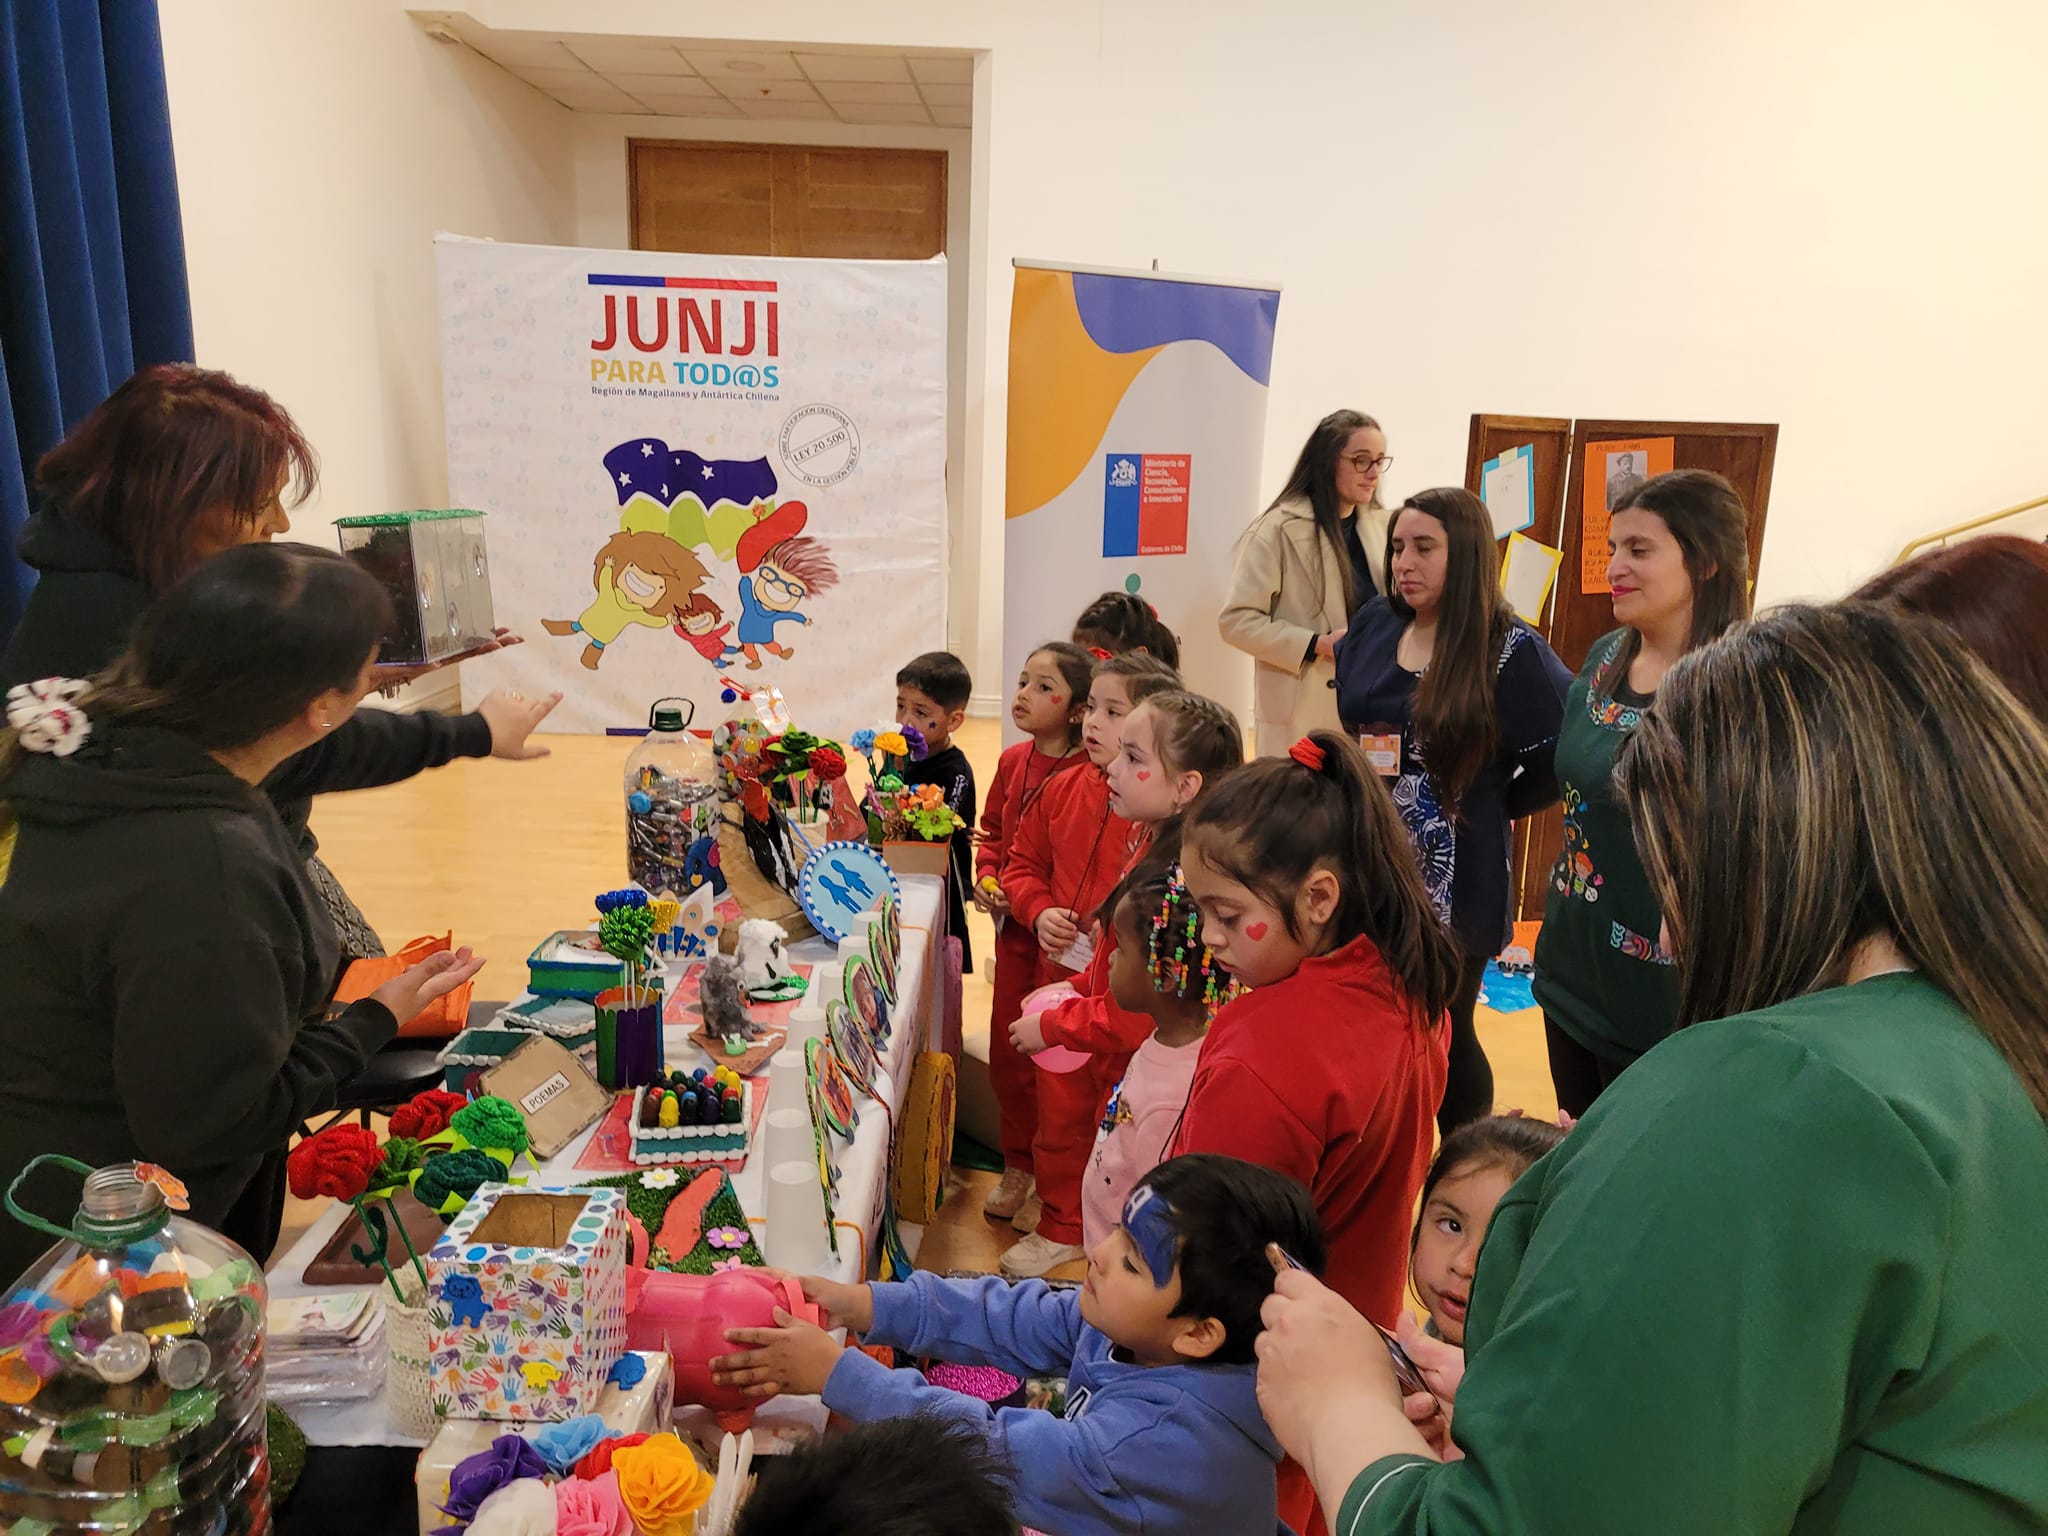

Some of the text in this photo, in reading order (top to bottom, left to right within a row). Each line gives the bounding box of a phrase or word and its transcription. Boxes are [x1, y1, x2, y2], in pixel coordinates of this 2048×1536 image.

[590, 295, 779, 357] JUNJI
[590, 359, 779, 388] PARA TOD@S
[591, 386, 780, 401] Región de Magallanes y Antártica Chilena
[793, 431, 846, 462] LEY 20.500
[528, 1079, 565, 1109] POEMAS
